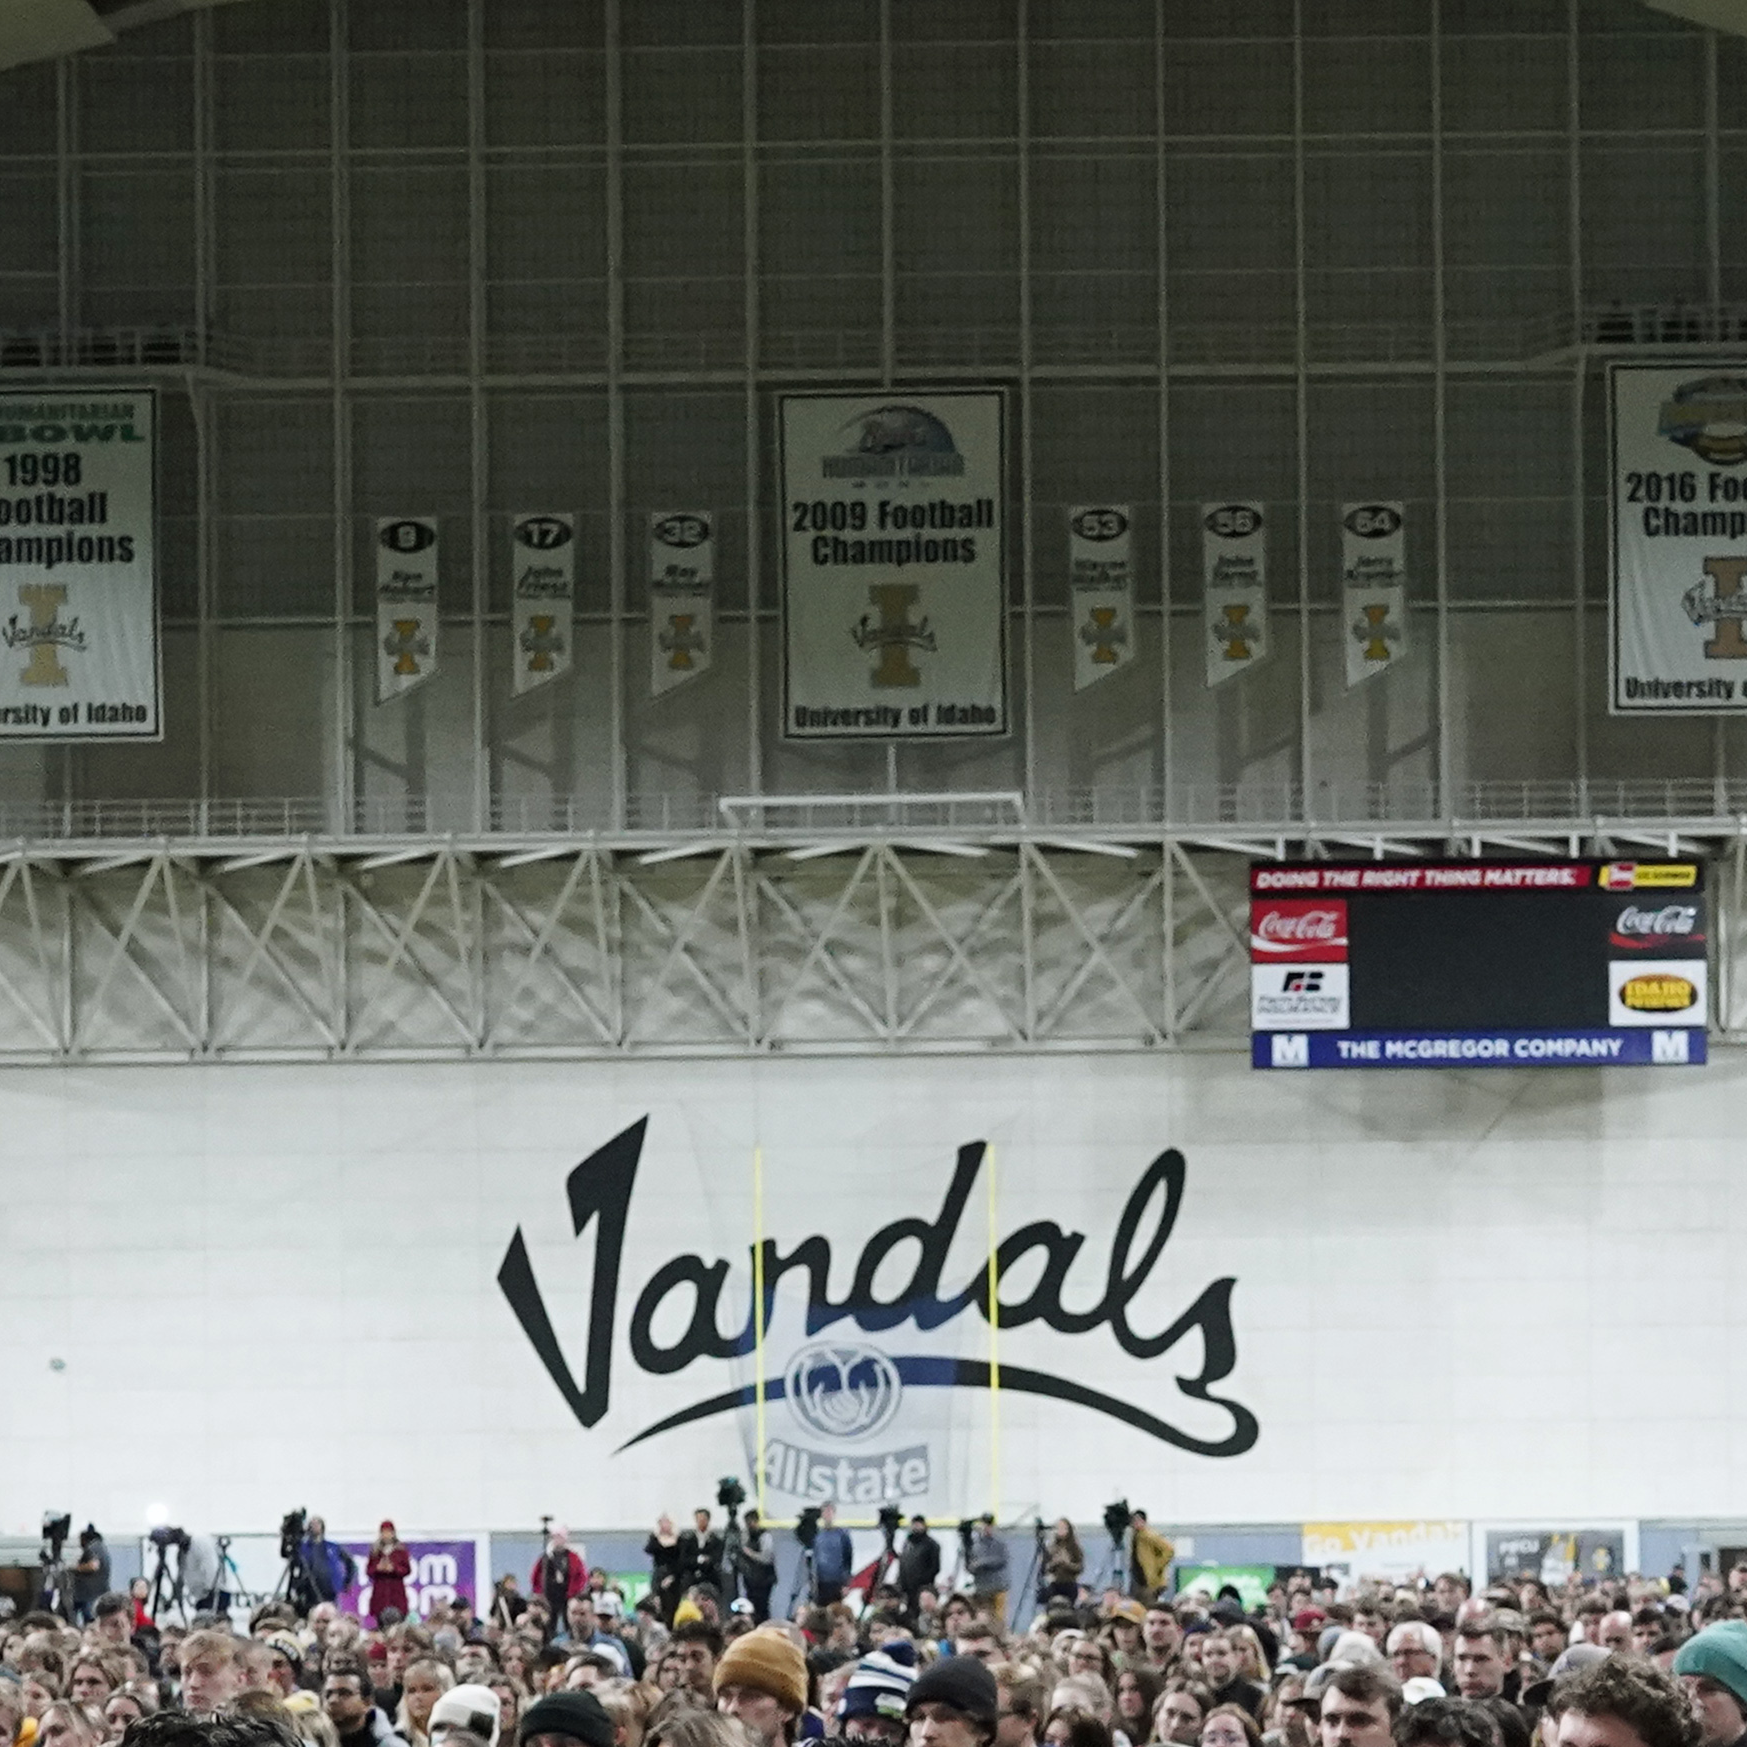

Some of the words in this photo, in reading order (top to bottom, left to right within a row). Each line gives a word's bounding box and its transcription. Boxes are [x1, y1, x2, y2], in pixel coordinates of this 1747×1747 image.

[4, 452, 82, 487] 1998
[1625, 471, 1697, 503] 2016
[878, 499, 994, 531] Football
[526, 523, 561, 545] 17
[811, 533, 977, 567] Champions
[1625, 677, 1735, 701] University
[58, 701, 80, 725] of
[86, 702, 148, 725] Idaho
[1256, 871, 1319, 889] DOING
[1323, 869, 1360, 887] THE
[1362, 869, 1421, 887] RIGHT
[1424, 868, 1482, 886] THING
[1271, 1034, 1310, 1067] M
[1337, 1040, 1380, 1059] THE
[1386, 1038, 1510, 1059] MCGREGOR
[1513, 1037, 1624, 1058] COMPANY
[1652, 1030, 1690, 1064] M
[497, 1113, 1258, 1457] Vandals
[762, 1437, 928, 1503] Allstate
